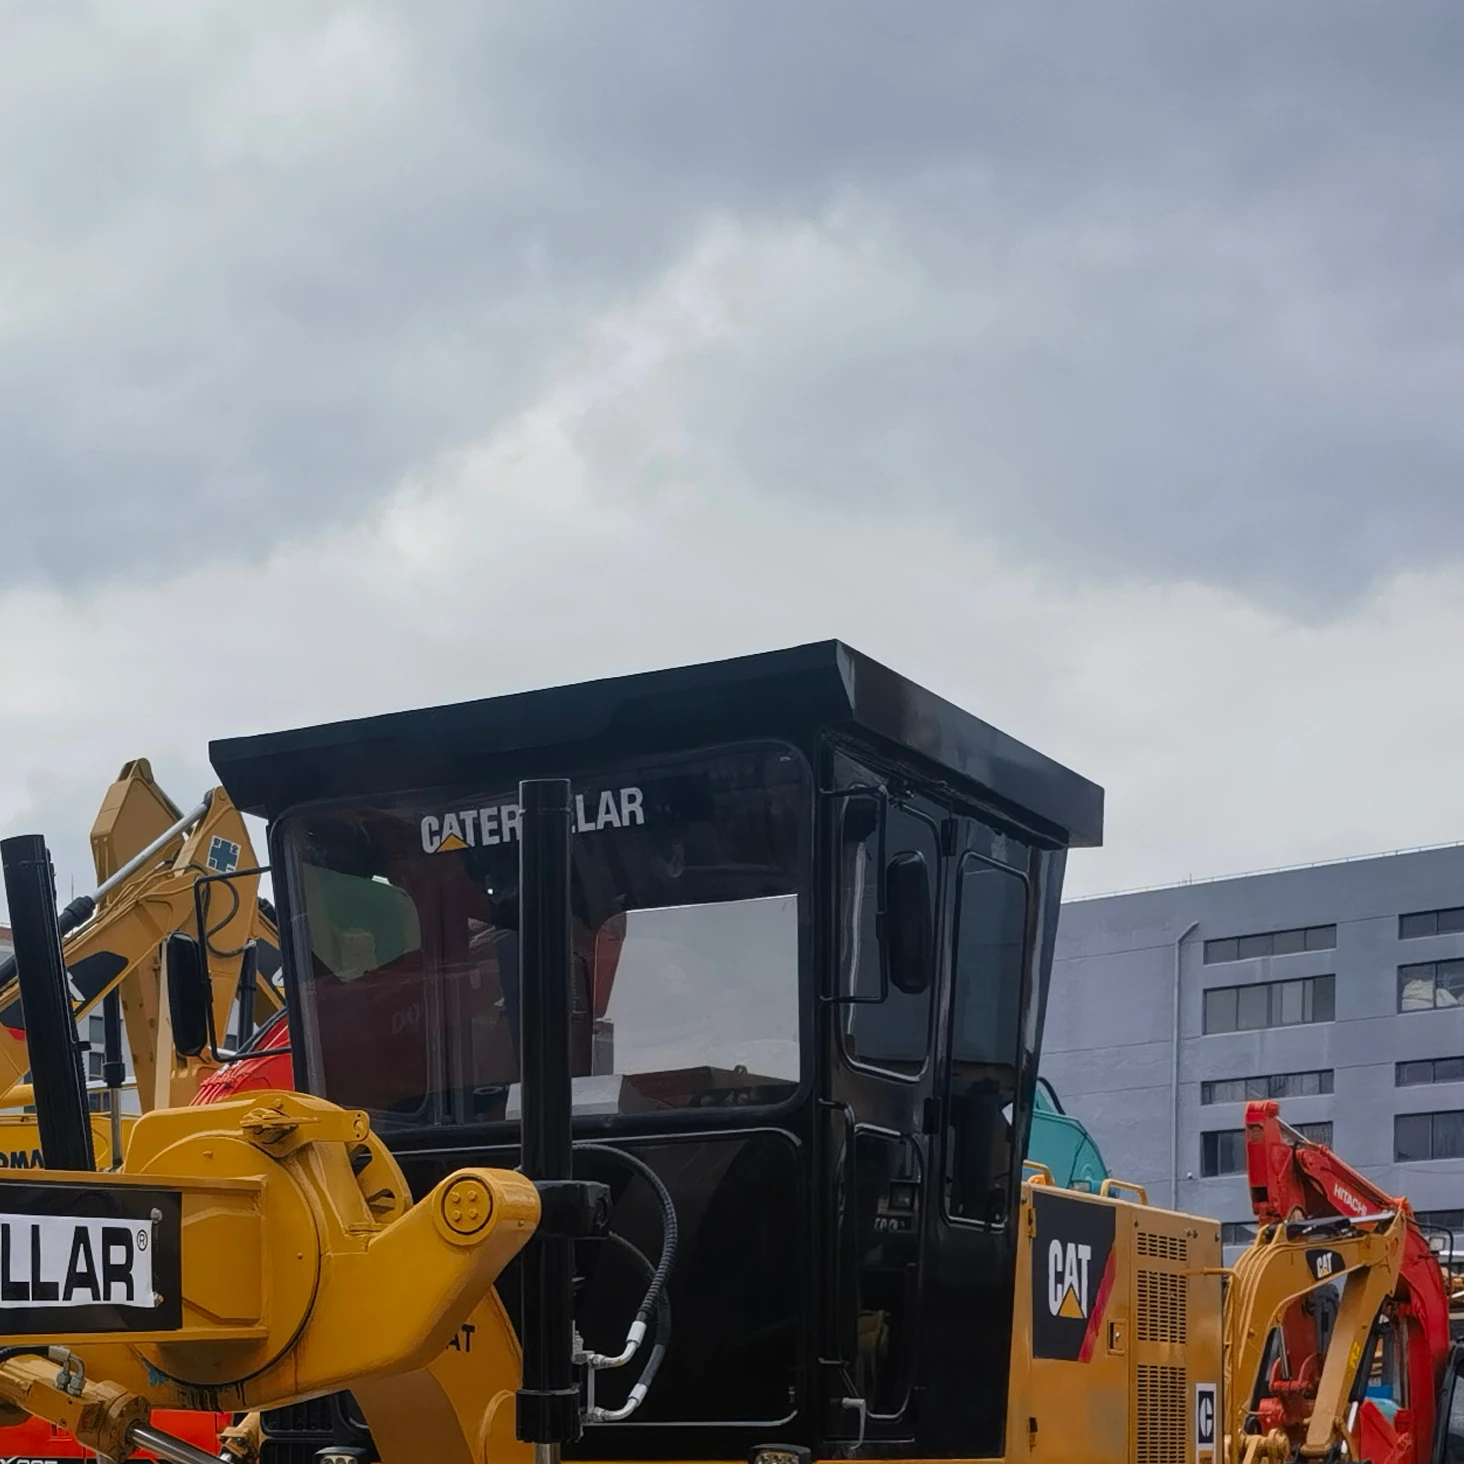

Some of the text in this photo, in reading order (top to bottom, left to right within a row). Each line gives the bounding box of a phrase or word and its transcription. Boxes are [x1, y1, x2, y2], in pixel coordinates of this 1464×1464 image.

[421, 787, 645, 854] CATERLAR
[1334, 1183, 1368, 1216] HITACHI
[1048, 1239, 1092, 1319] CAT
[1316, 1252, 1333, 1279] CAT
[446, 1323, 476, 1352] AT
